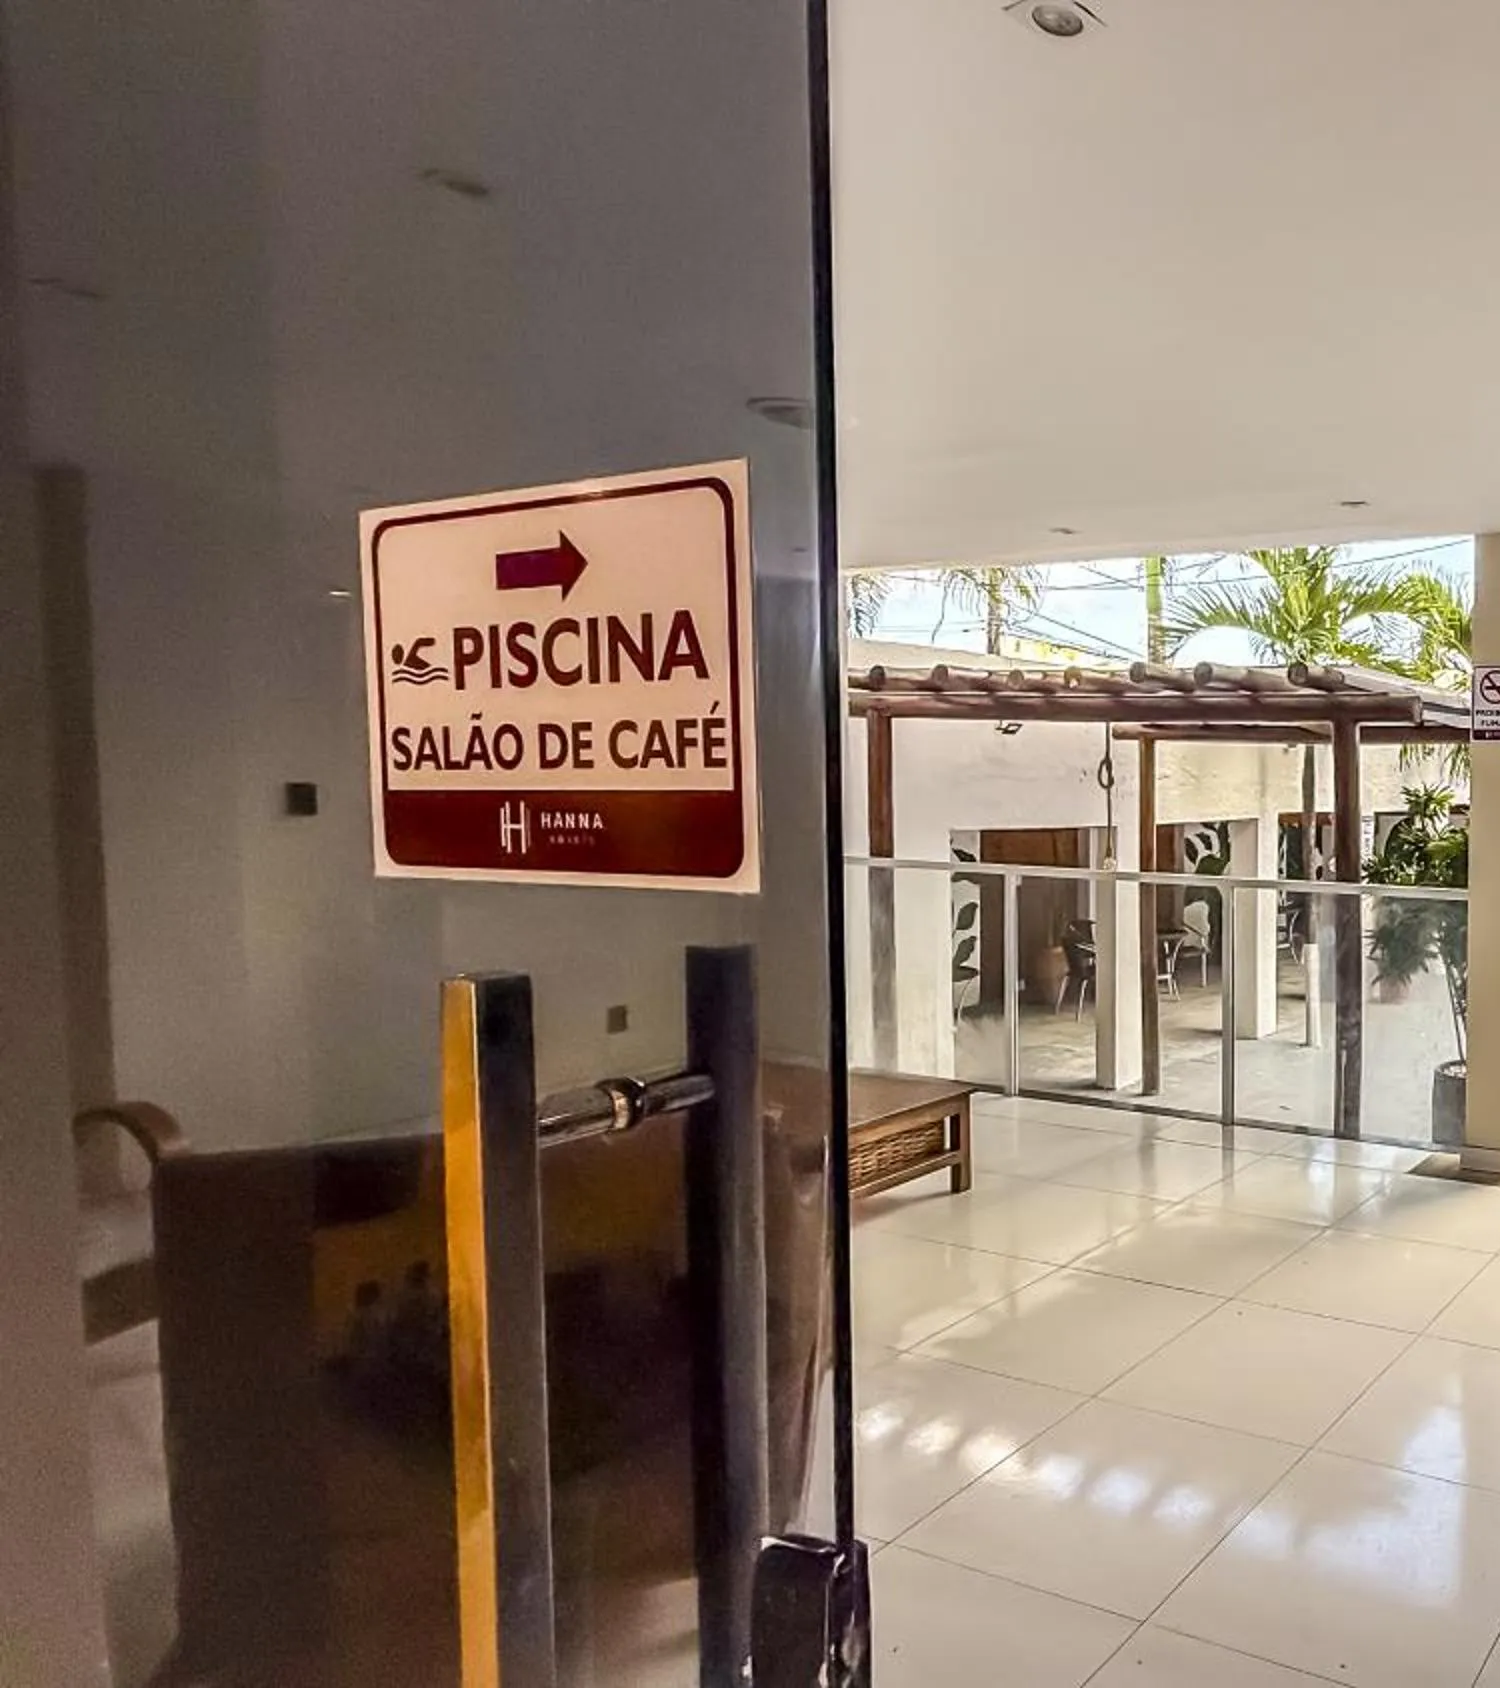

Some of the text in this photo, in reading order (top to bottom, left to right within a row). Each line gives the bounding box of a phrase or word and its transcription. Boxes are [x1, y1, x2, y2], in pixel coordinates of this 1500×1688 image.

[453, 609, 710, 690] PISCINA
[391, 700, 728, 771] SALÃO DE CAFÉ
[540, 811, 604, 830] HANNA
